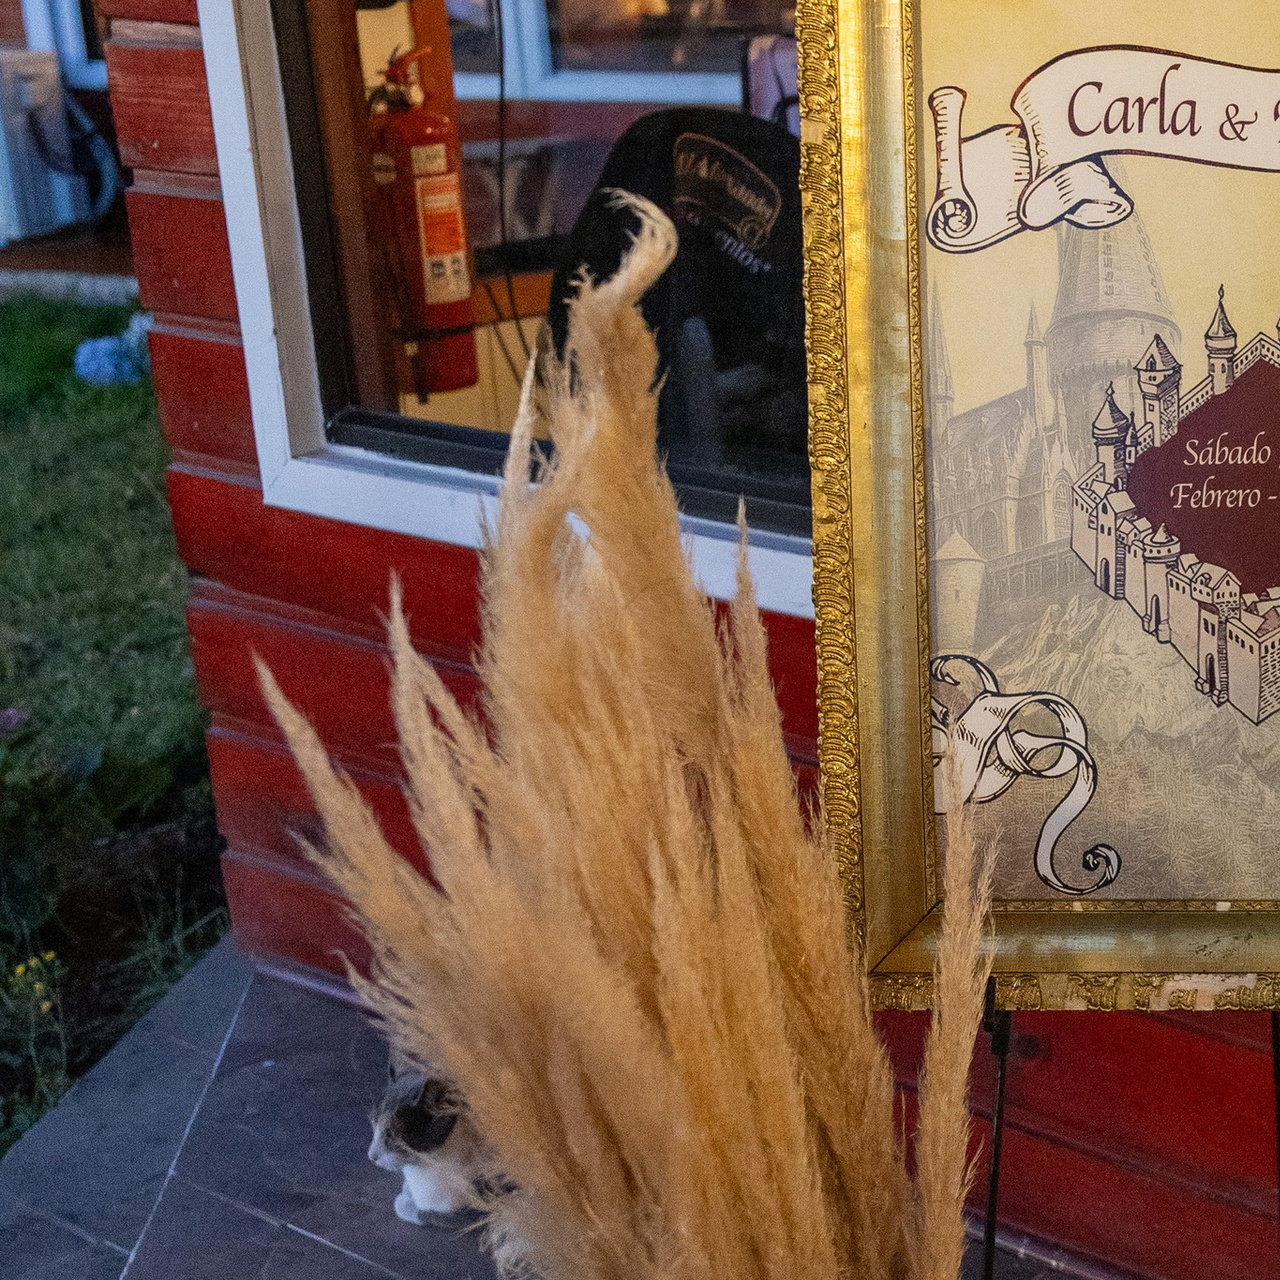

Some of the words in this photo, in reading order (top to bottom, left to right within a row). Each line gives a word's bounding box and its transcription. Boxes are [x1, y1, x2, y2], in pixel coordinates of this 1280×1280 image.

[1067, 63, 1202, 137] Carla
[1218, 103, 1258, 142] &
[1183, 431, 1271, 466] Sábado
[1170, 475, 1261, 509] Febrero
